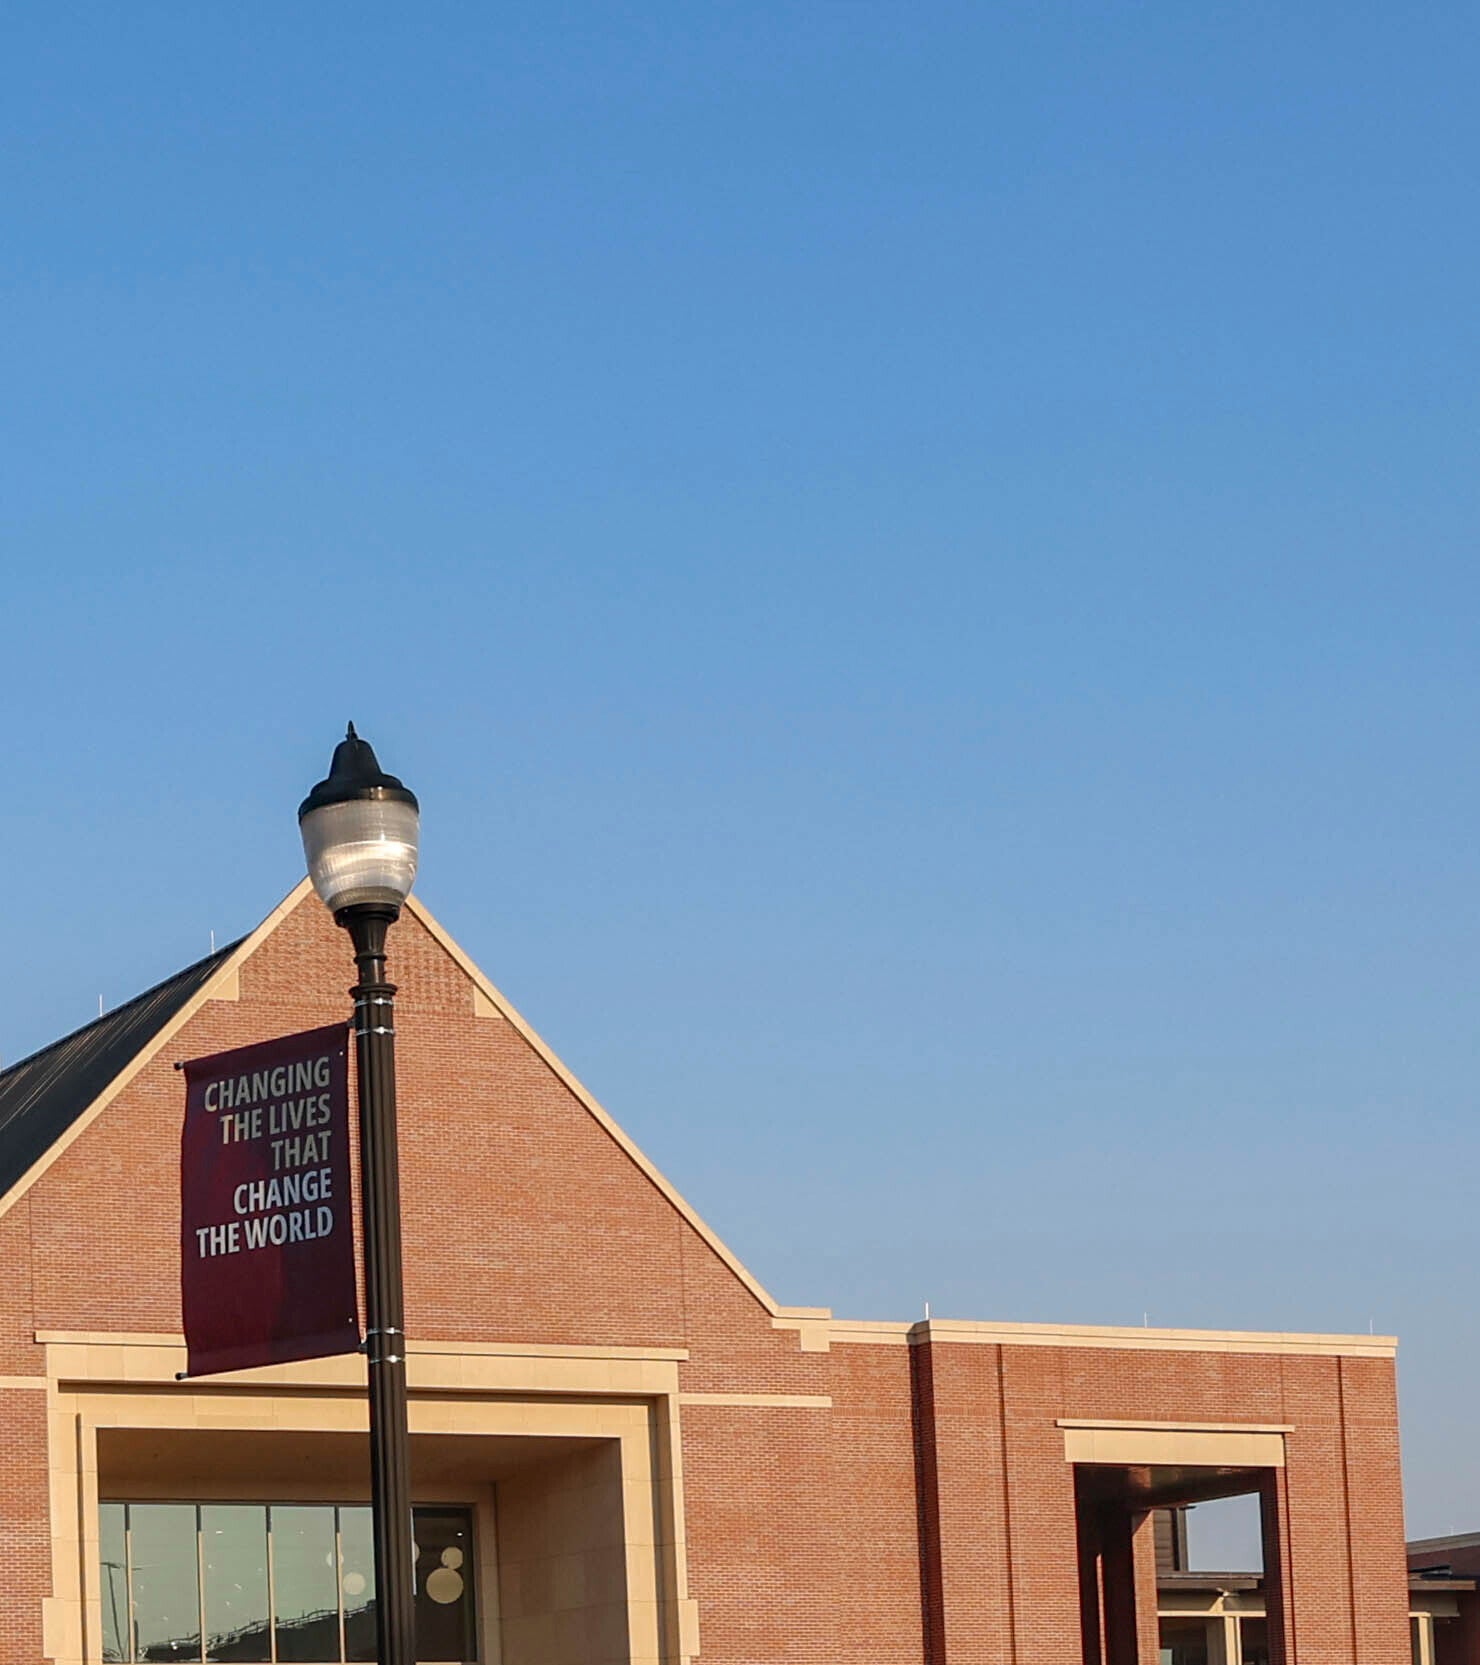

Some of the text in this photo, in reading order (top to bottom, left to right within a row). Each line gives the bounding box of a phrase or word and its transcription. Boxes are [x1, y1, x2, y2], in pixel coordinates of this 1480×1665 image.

[204, 1056, 331, 1113] CHANGING
[219, 1093, 332, 1145] THE LIVES
[271, 1130, 333, 1171] THAT
[233, 1167, 333, 1216] CHANGE
[196, 1205, 334, 1259] THE WORLD
